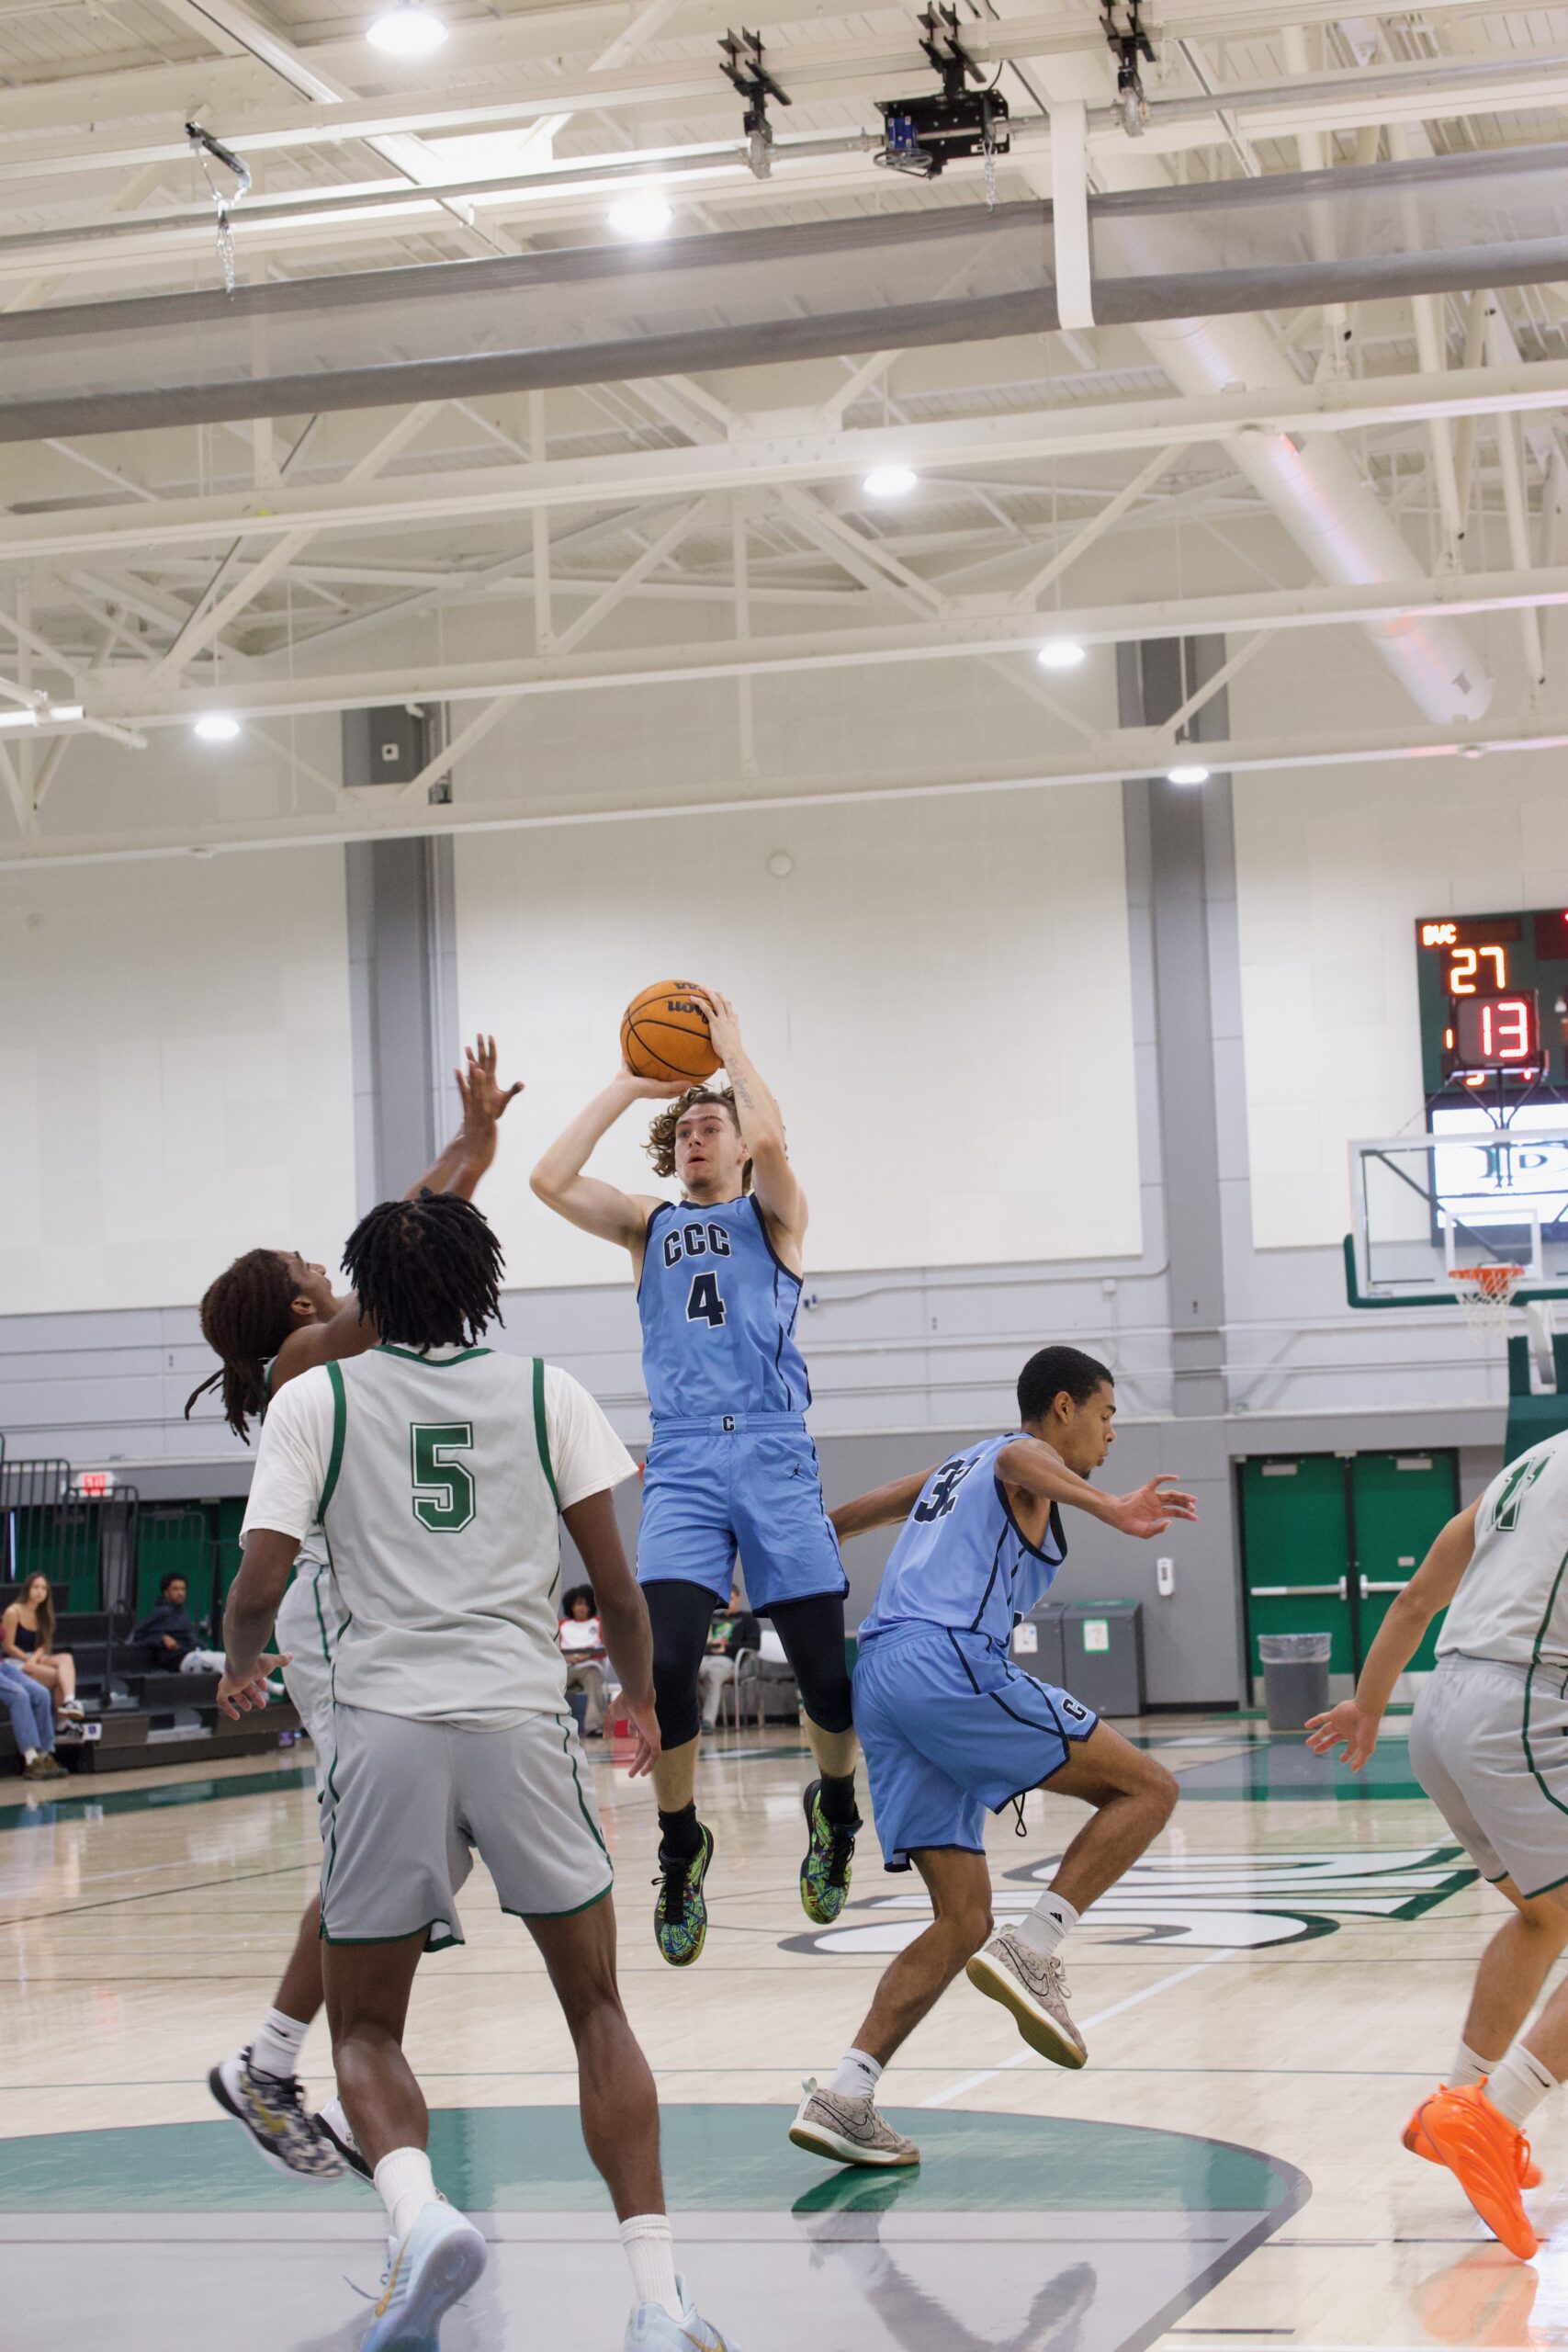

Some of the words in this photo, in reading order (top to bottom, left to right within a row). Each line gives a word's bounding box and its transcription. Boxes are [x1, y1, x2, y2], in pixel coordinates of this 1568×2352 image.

[1450, 945, 1506, 994] 27
[1482, 1001, 1529, 1057] 13
[663, 1222, 731, 1269] CCC
[685, 1271, 727, 1329] 4
[722, 1415, 735, 1432] C
[410, 1421, 476, 1532] 5
[1062, 1698, 1087, 1722] C
